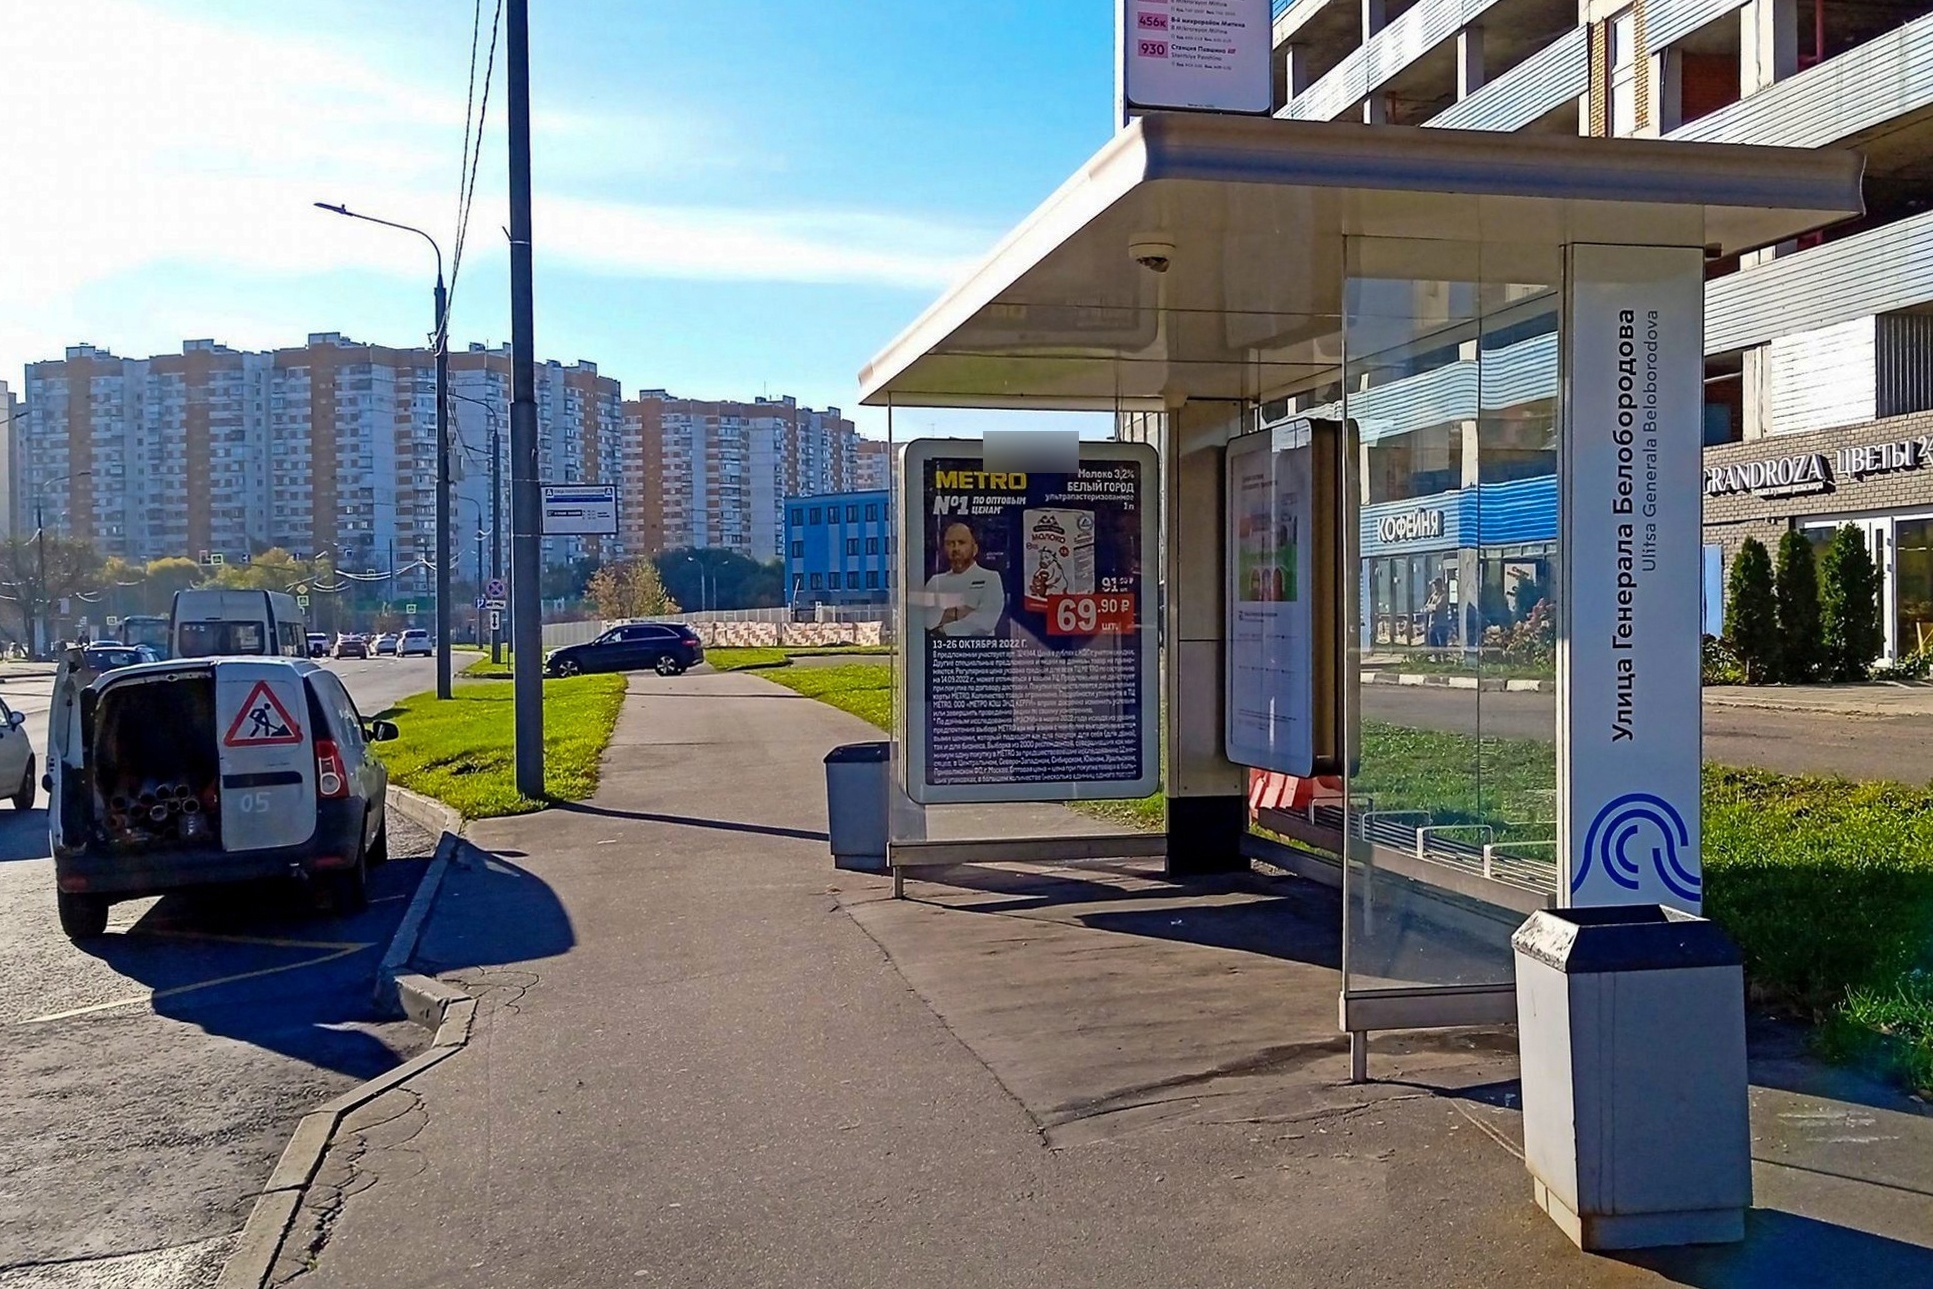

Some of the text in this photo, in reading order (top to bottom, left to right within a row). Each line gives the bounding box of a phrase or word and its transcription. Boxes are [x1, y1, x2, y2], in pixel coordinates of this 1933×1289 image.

[1141, 43, 1165, 55] 930
[1642, 311, 1659, 573] Ulitsa Generala Beloborodova
[1836, 441, 1912, 480] ЦВЕТЫ
[936, 471, 1027, 489] METRO
[1078, 469, 1135, 480] Молоко 3,2%
[1067, 480, 1134, 493] БЕЛЫЙ ГОРОД
[972, 496, 985, 505] ПО
[986, 496, 1027, 505] ОПТОВЫМ
[1045, 493, 1134, 502] ультрапастеризованное
[1377, 508, 1439, 542] КОФЕЙНЯ
[1612, 309, 1638, 743] Улица Генерала Белобородова
[932, 640, 957, 649] 13-26
[958, 640, 998, 649] ОКТЯБРЯ
[999, 640, 1020, 649] 2022
